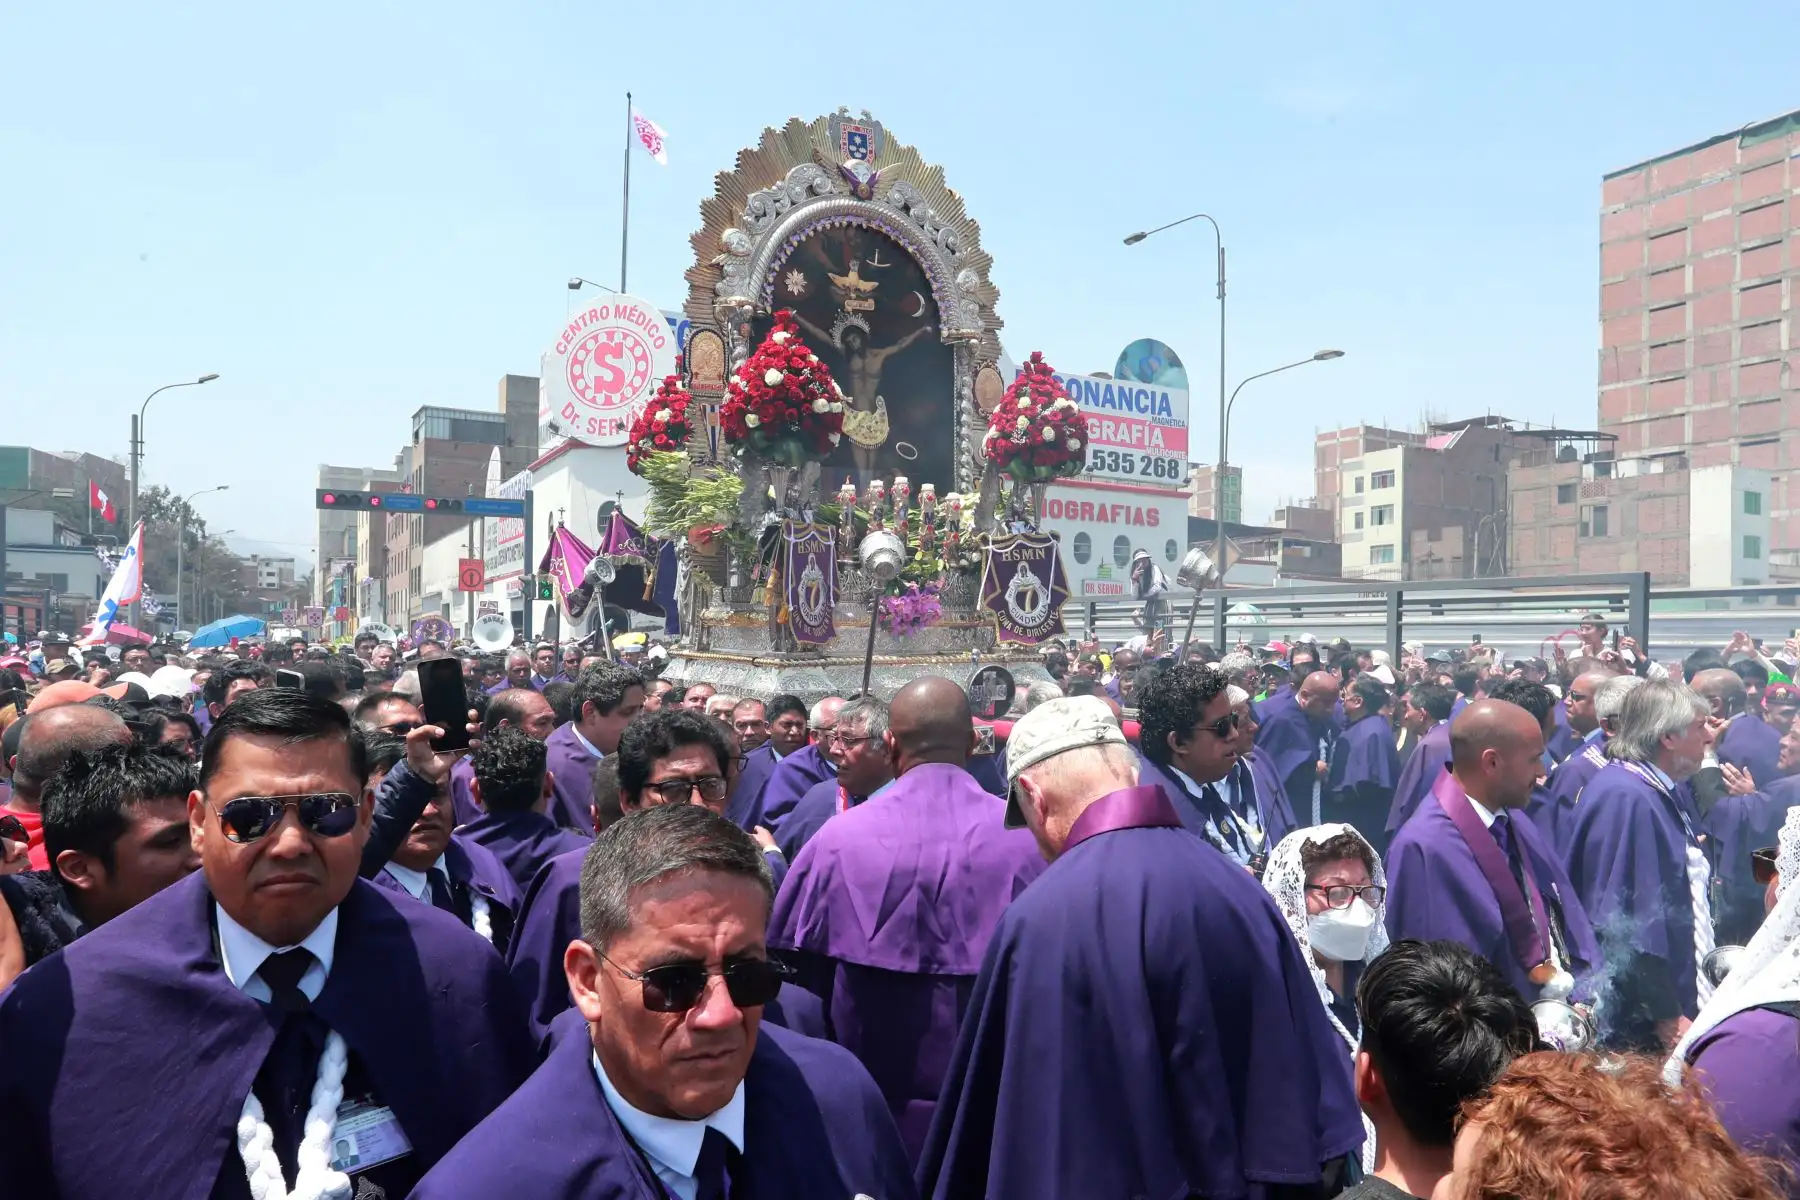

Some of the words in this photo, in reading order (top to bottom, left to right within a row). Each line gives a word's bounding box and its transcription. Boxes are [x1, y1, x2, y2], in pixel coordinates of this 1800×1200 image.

[555, 305, 610, 355] CENTRO
[614, 304, 666, 350] MÉDICO
[593, 341, 625, 396] S
[560, 401, 581, 430] Dr.
[1088, 418, 1165, 448] GRAFÍA
[1092, 449, 1135, 474] 535
[1140, 455, 1180, 480] 268
[1001, 548, 1045, 562] HSMN
[1017, 584, 1035, 613] 7
[997, 609, 1012, 631] CUNA
[1014, 624, 1026, 636] DE
[1011, 604, 1048, 624] CUADRILLA
